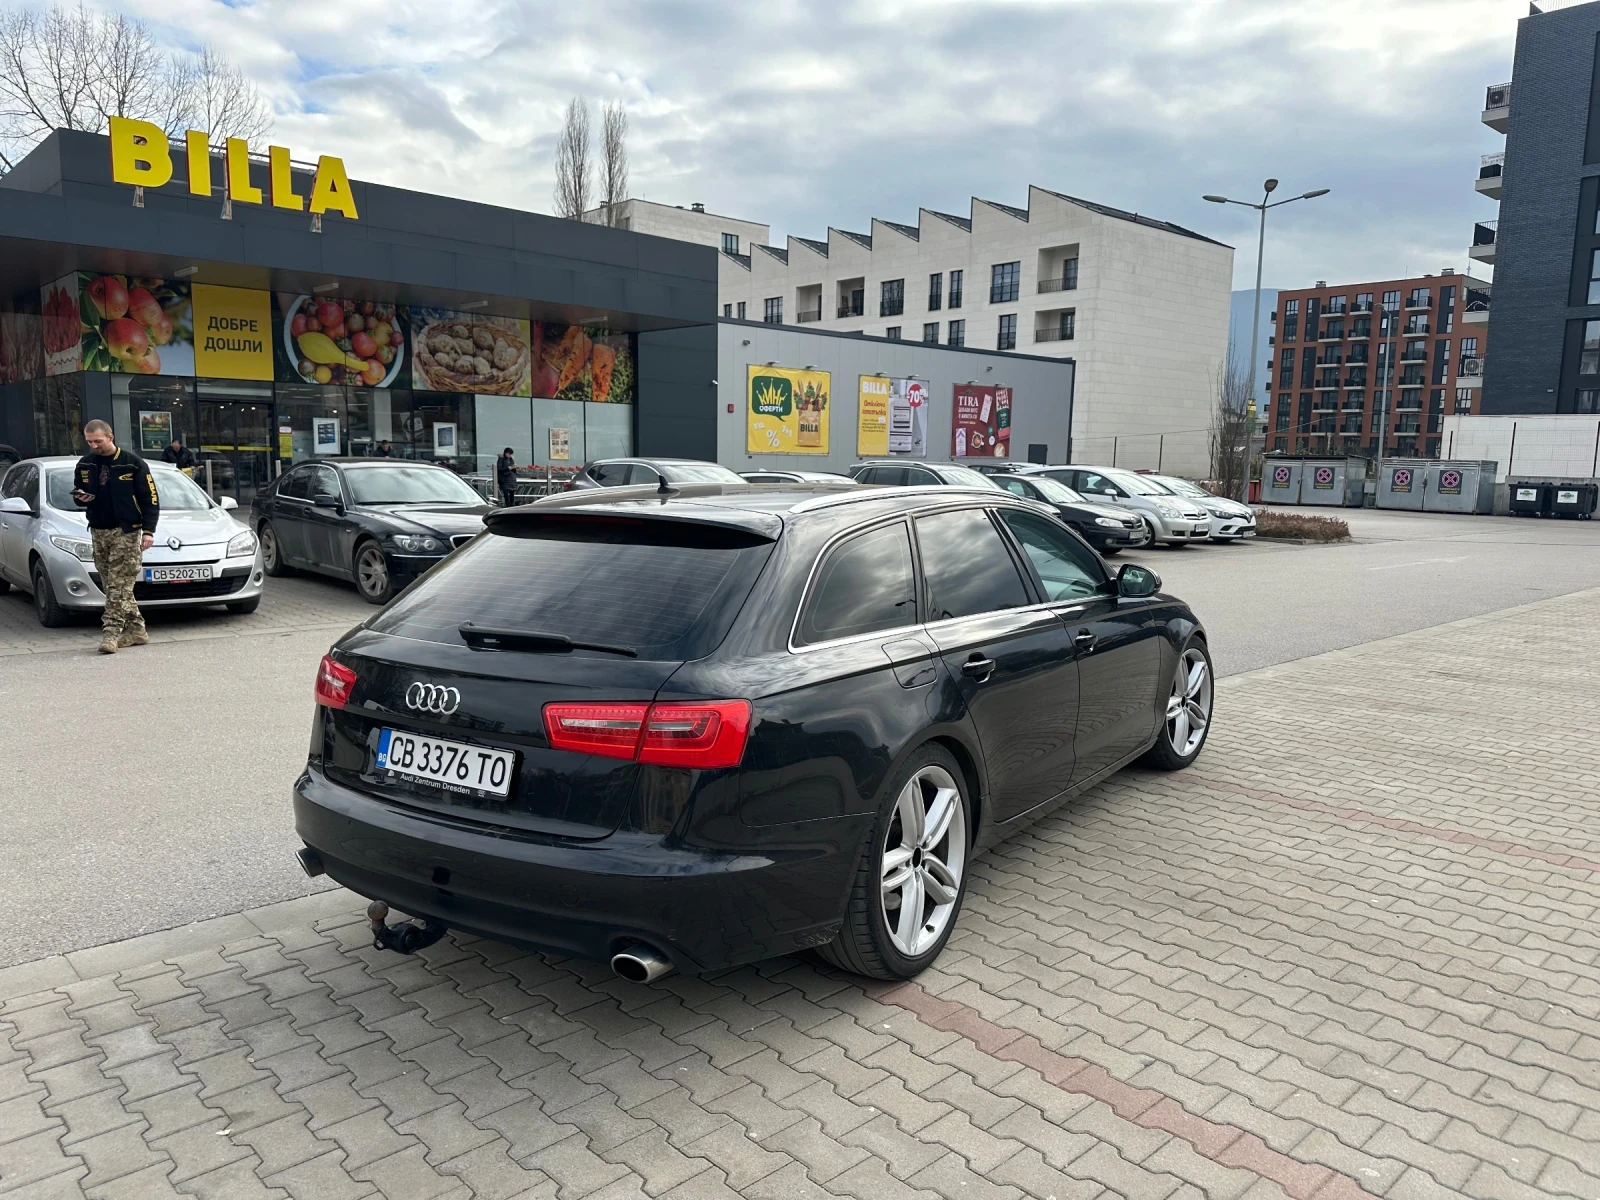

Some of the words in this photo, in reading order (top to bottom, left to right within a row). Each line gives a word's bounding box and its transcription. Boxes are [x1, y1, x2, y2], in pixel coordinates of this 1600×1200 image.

[109, 115, 359, 219] BILLA
[207, 315, 259, 333] ДОБРЕ
[204, 336, 263, 353] ДОШЛИ
[756, 380, 788, 406] КИНГ
[862, 381, 887, 395] BILLA
[759, 405, 783, 413] ОФЕРТИ
[957, 395, 979, 407] TIRA
[800, 423, 819, 433] BILLA
[766, 429, 780, 447] %
[146, 473, 158, 506] SUBARU
[153, 570, 168, 580] CB
[169, 568, 195, 579] 5202
[195, 568, 210, 578] TC
[377, 752, 387, 762] BG
[389, 736, 415, 768] CB
[417, 742, 470, 780] 3376
[400, 772, 414, 784] Audi
[414, 777, 441, 789] Zentrum
[442, 783, 470, 795] Dresden
